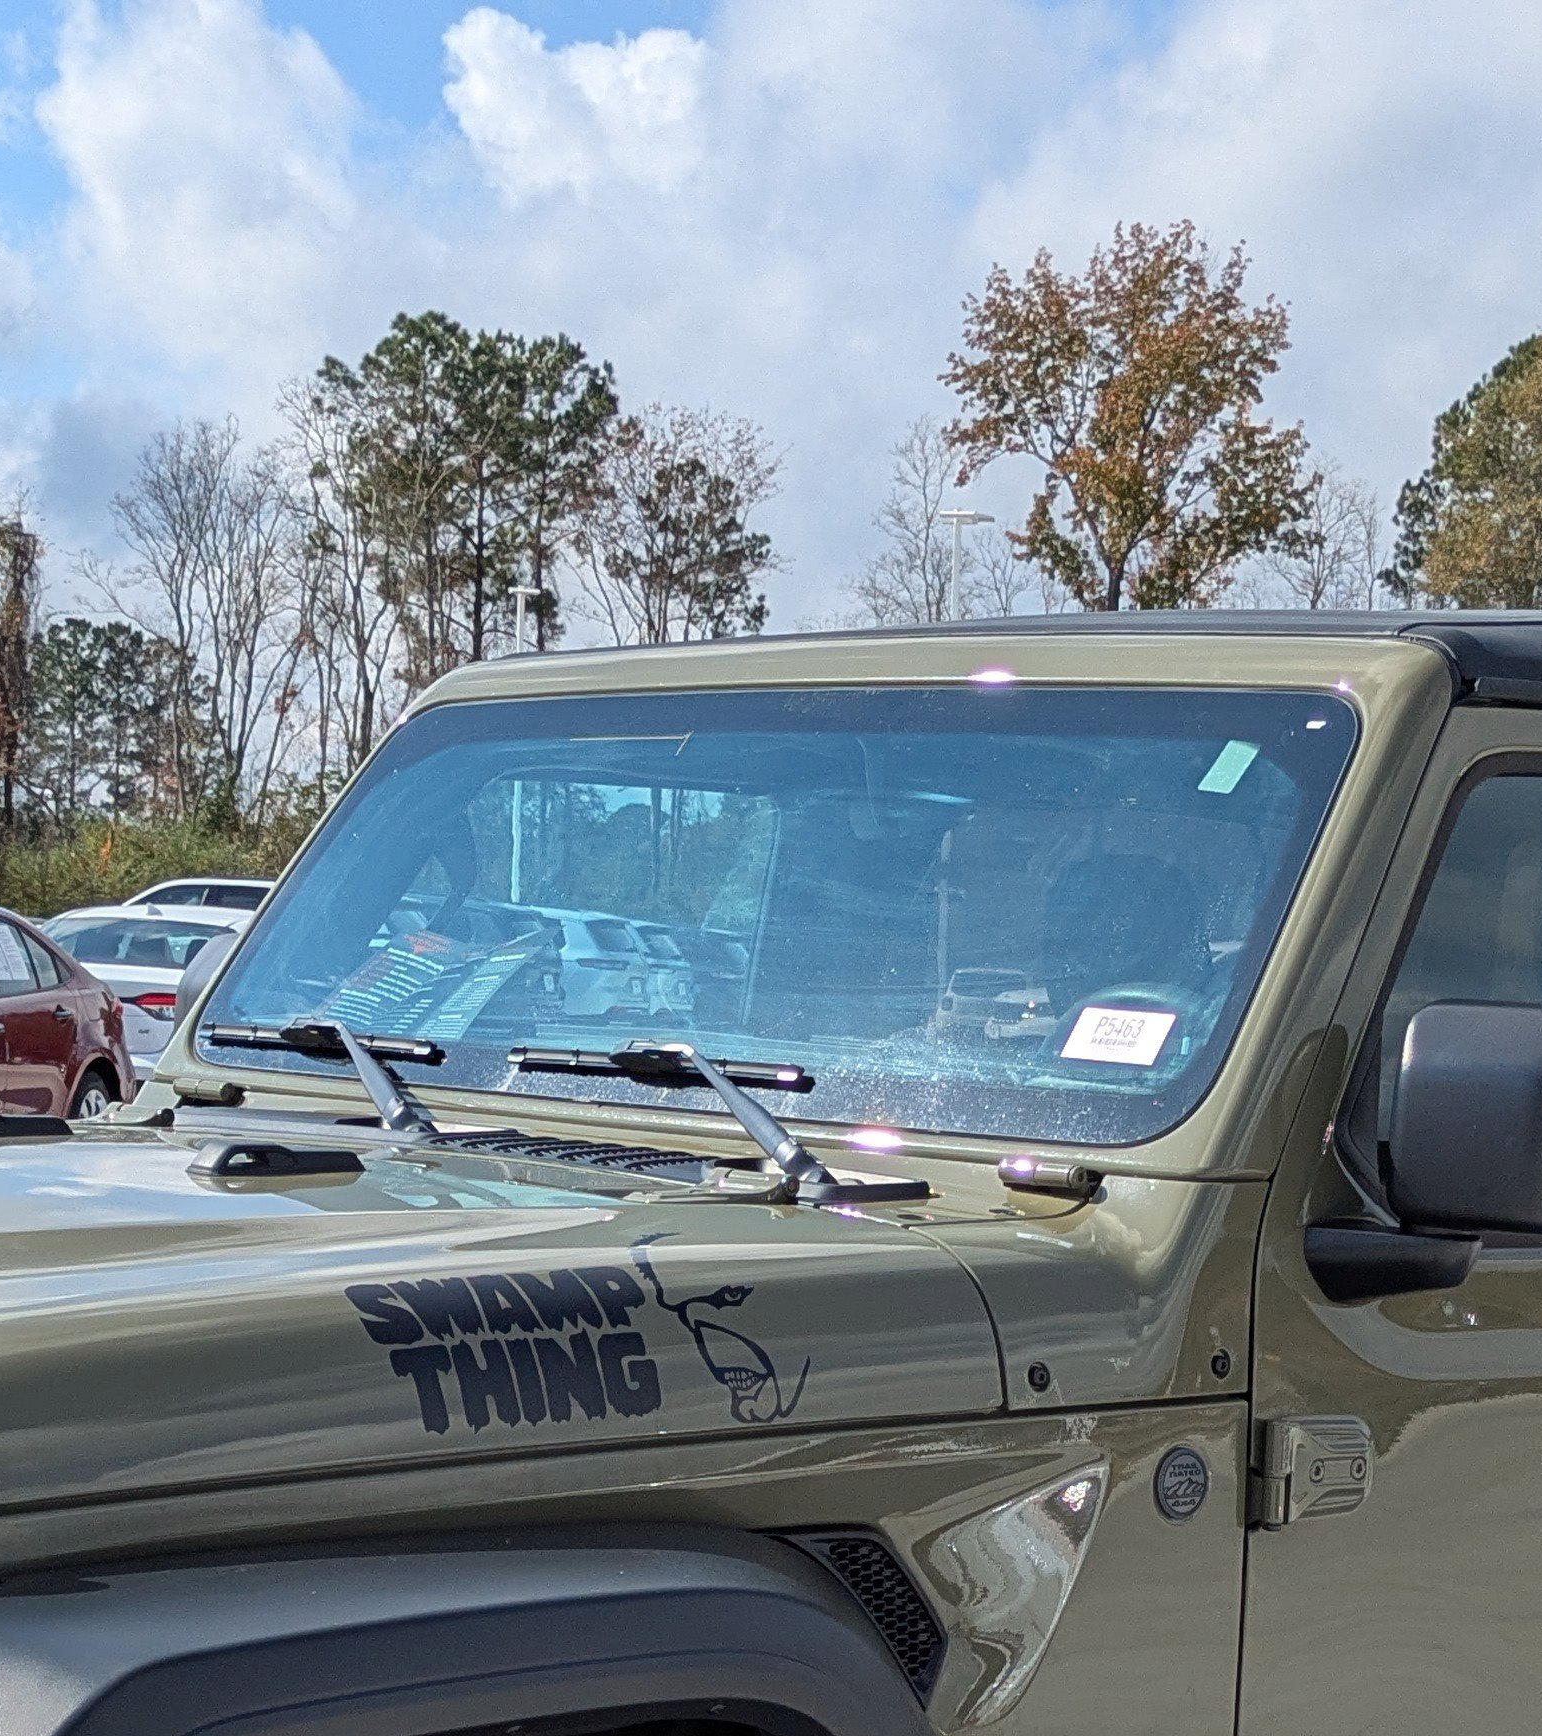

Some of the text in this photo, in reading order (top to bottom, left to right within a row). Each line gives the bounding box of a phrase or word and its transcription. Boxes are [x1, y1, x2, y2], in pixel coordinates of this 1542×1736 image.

[1093, 1015, 1146, 1039] P5463
[344, 1266, 646, 1345] SWAMP
[390, 1333, 662, 1435] THING
[1169, 1469, 1201, 1478] RATED
